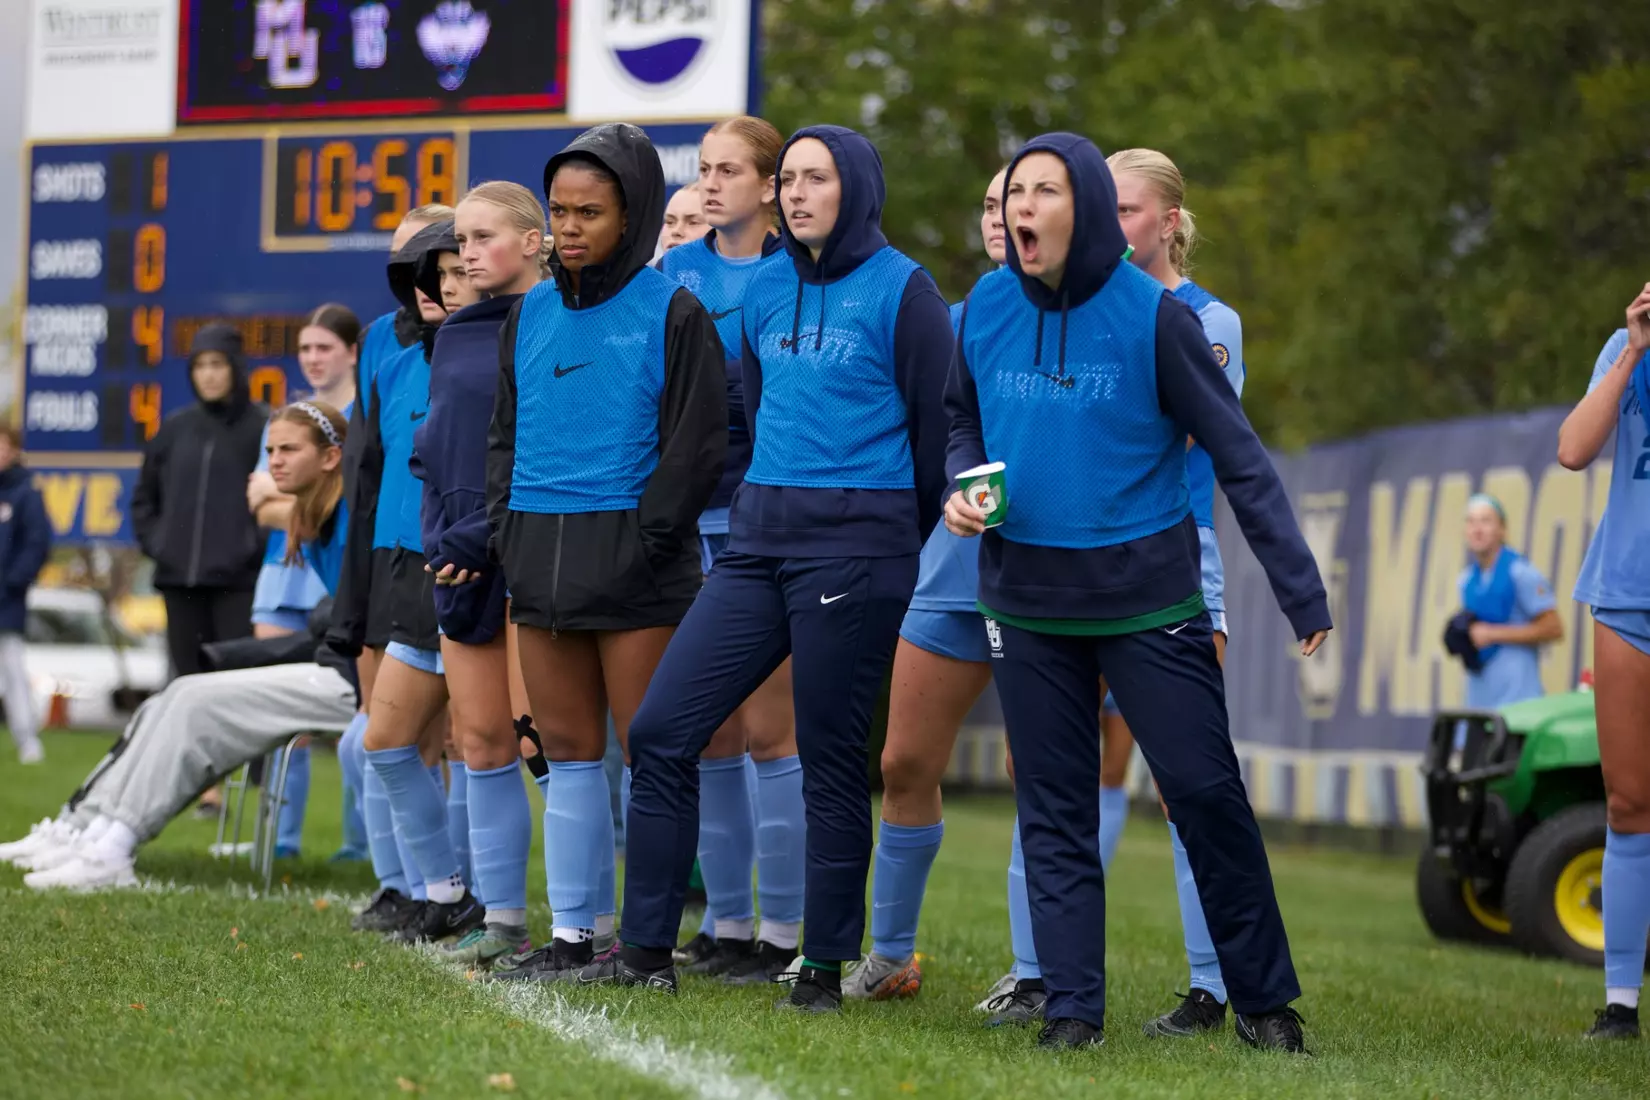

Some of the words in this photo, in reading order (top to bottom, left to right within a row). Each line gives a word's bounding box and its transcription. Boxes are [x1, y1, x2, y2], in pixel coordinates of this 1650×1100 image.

[33, 162, 106, 202] SHOTS
[152, 153, 168, 209] 1
[294, 140, 457, 231] 10:58
[31, 239, 102, 279] SAVES
[134, 223, 166, 292] 0
[25, 304, 108, 344] CORNER
[131, 304, 164, 366] 4
[30, 339, 97, 376] KICKS
[26, 391, 99, 431] FOULS
[129, 383, 162, 441] 4
